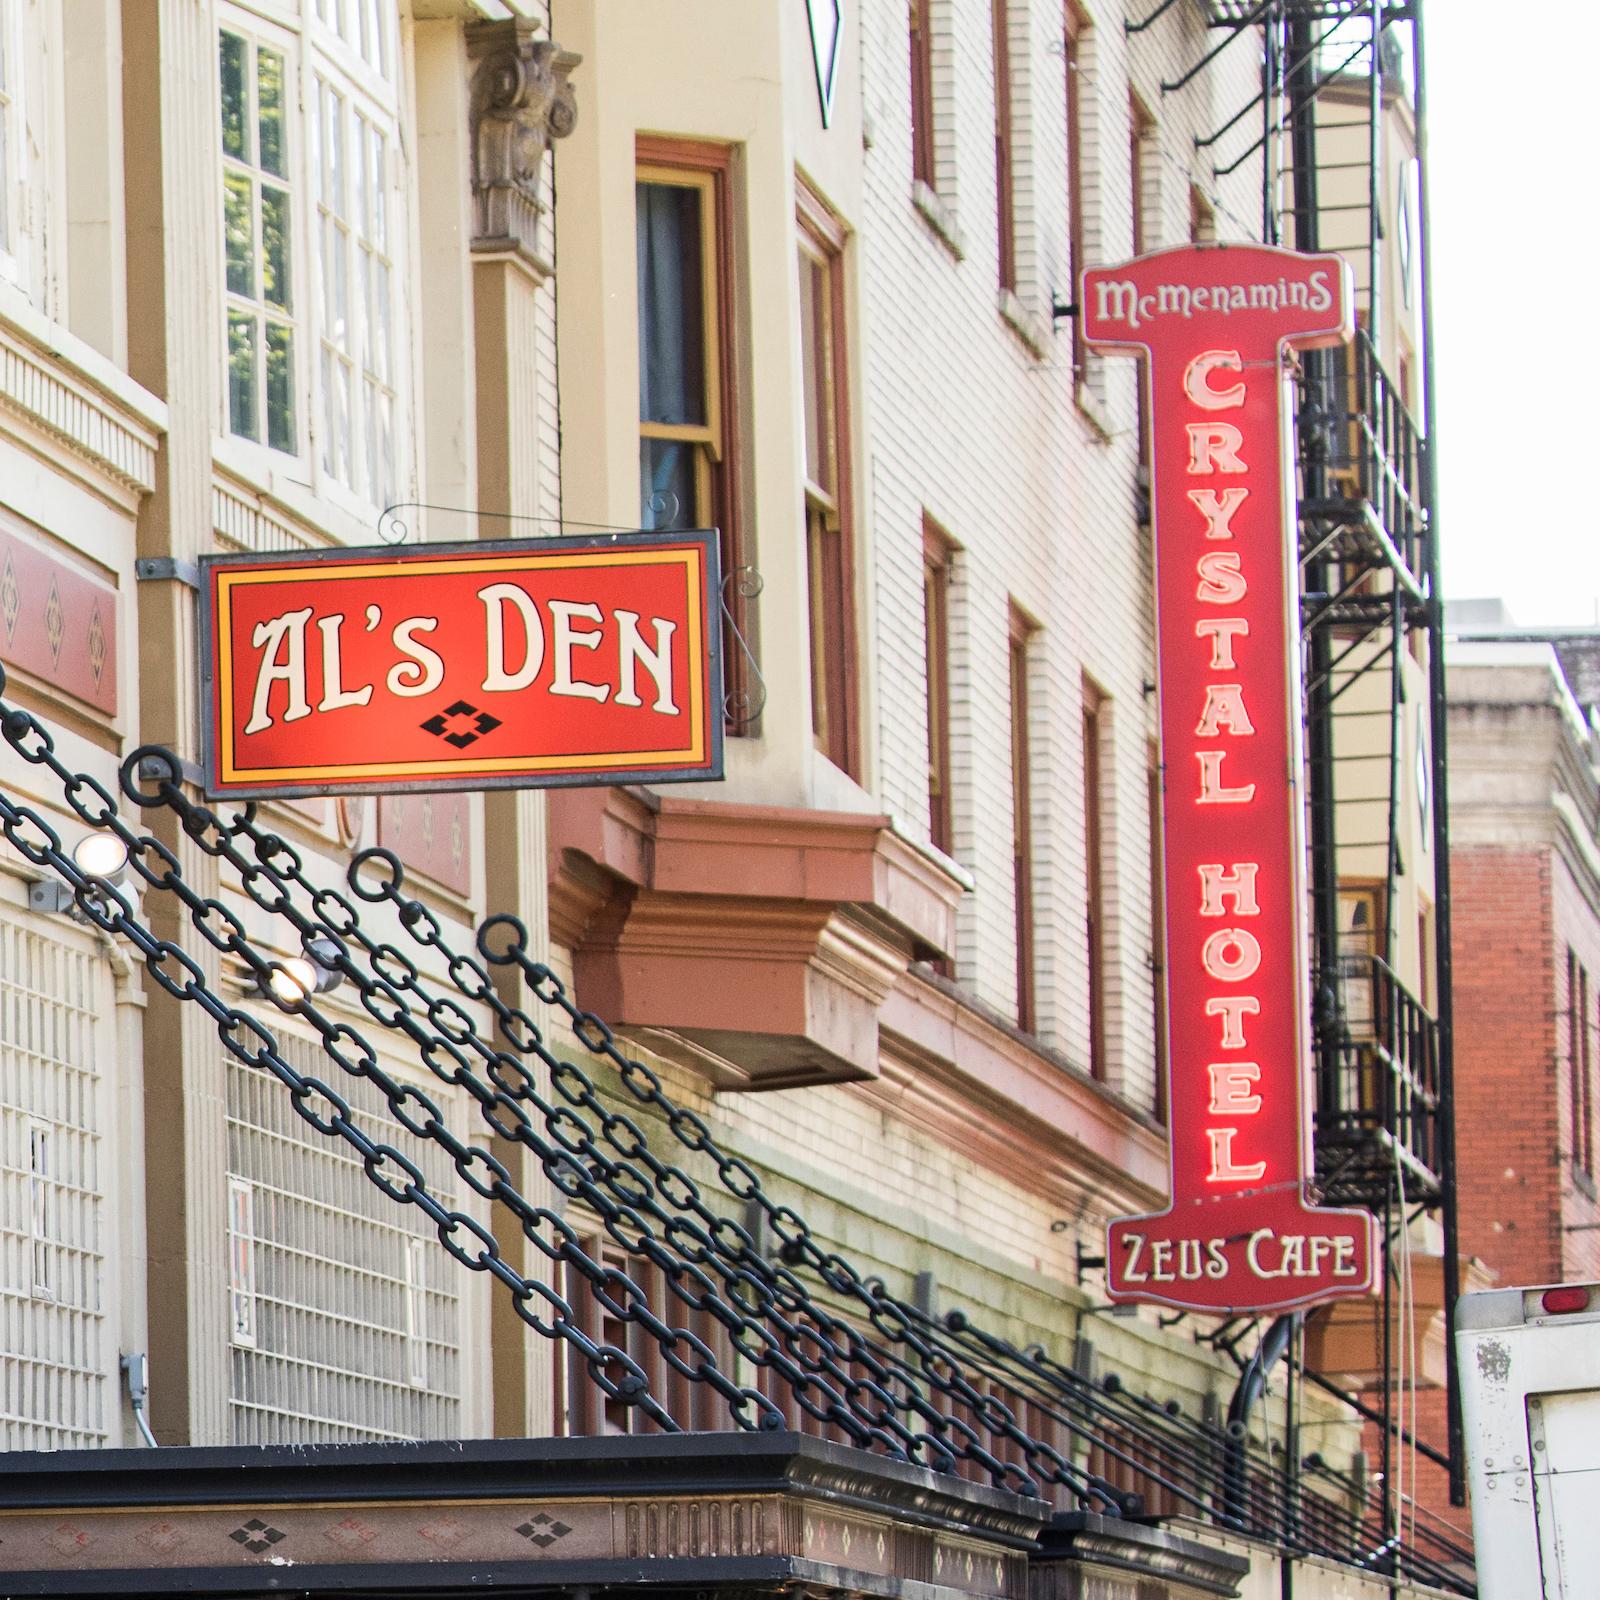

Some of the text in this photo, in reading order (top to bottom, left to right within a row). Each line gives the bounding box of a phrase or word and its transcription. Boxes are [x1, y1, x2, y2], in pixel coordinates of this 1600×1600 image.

[244, 582, 681, 736] AL'S DEN
[1183, 347, 1257, 807] CRYSTAL
[1196, 861, 1268, 1185] HOTEL
[1121, 1228, 1358, 1282] ZEUS CAFE
